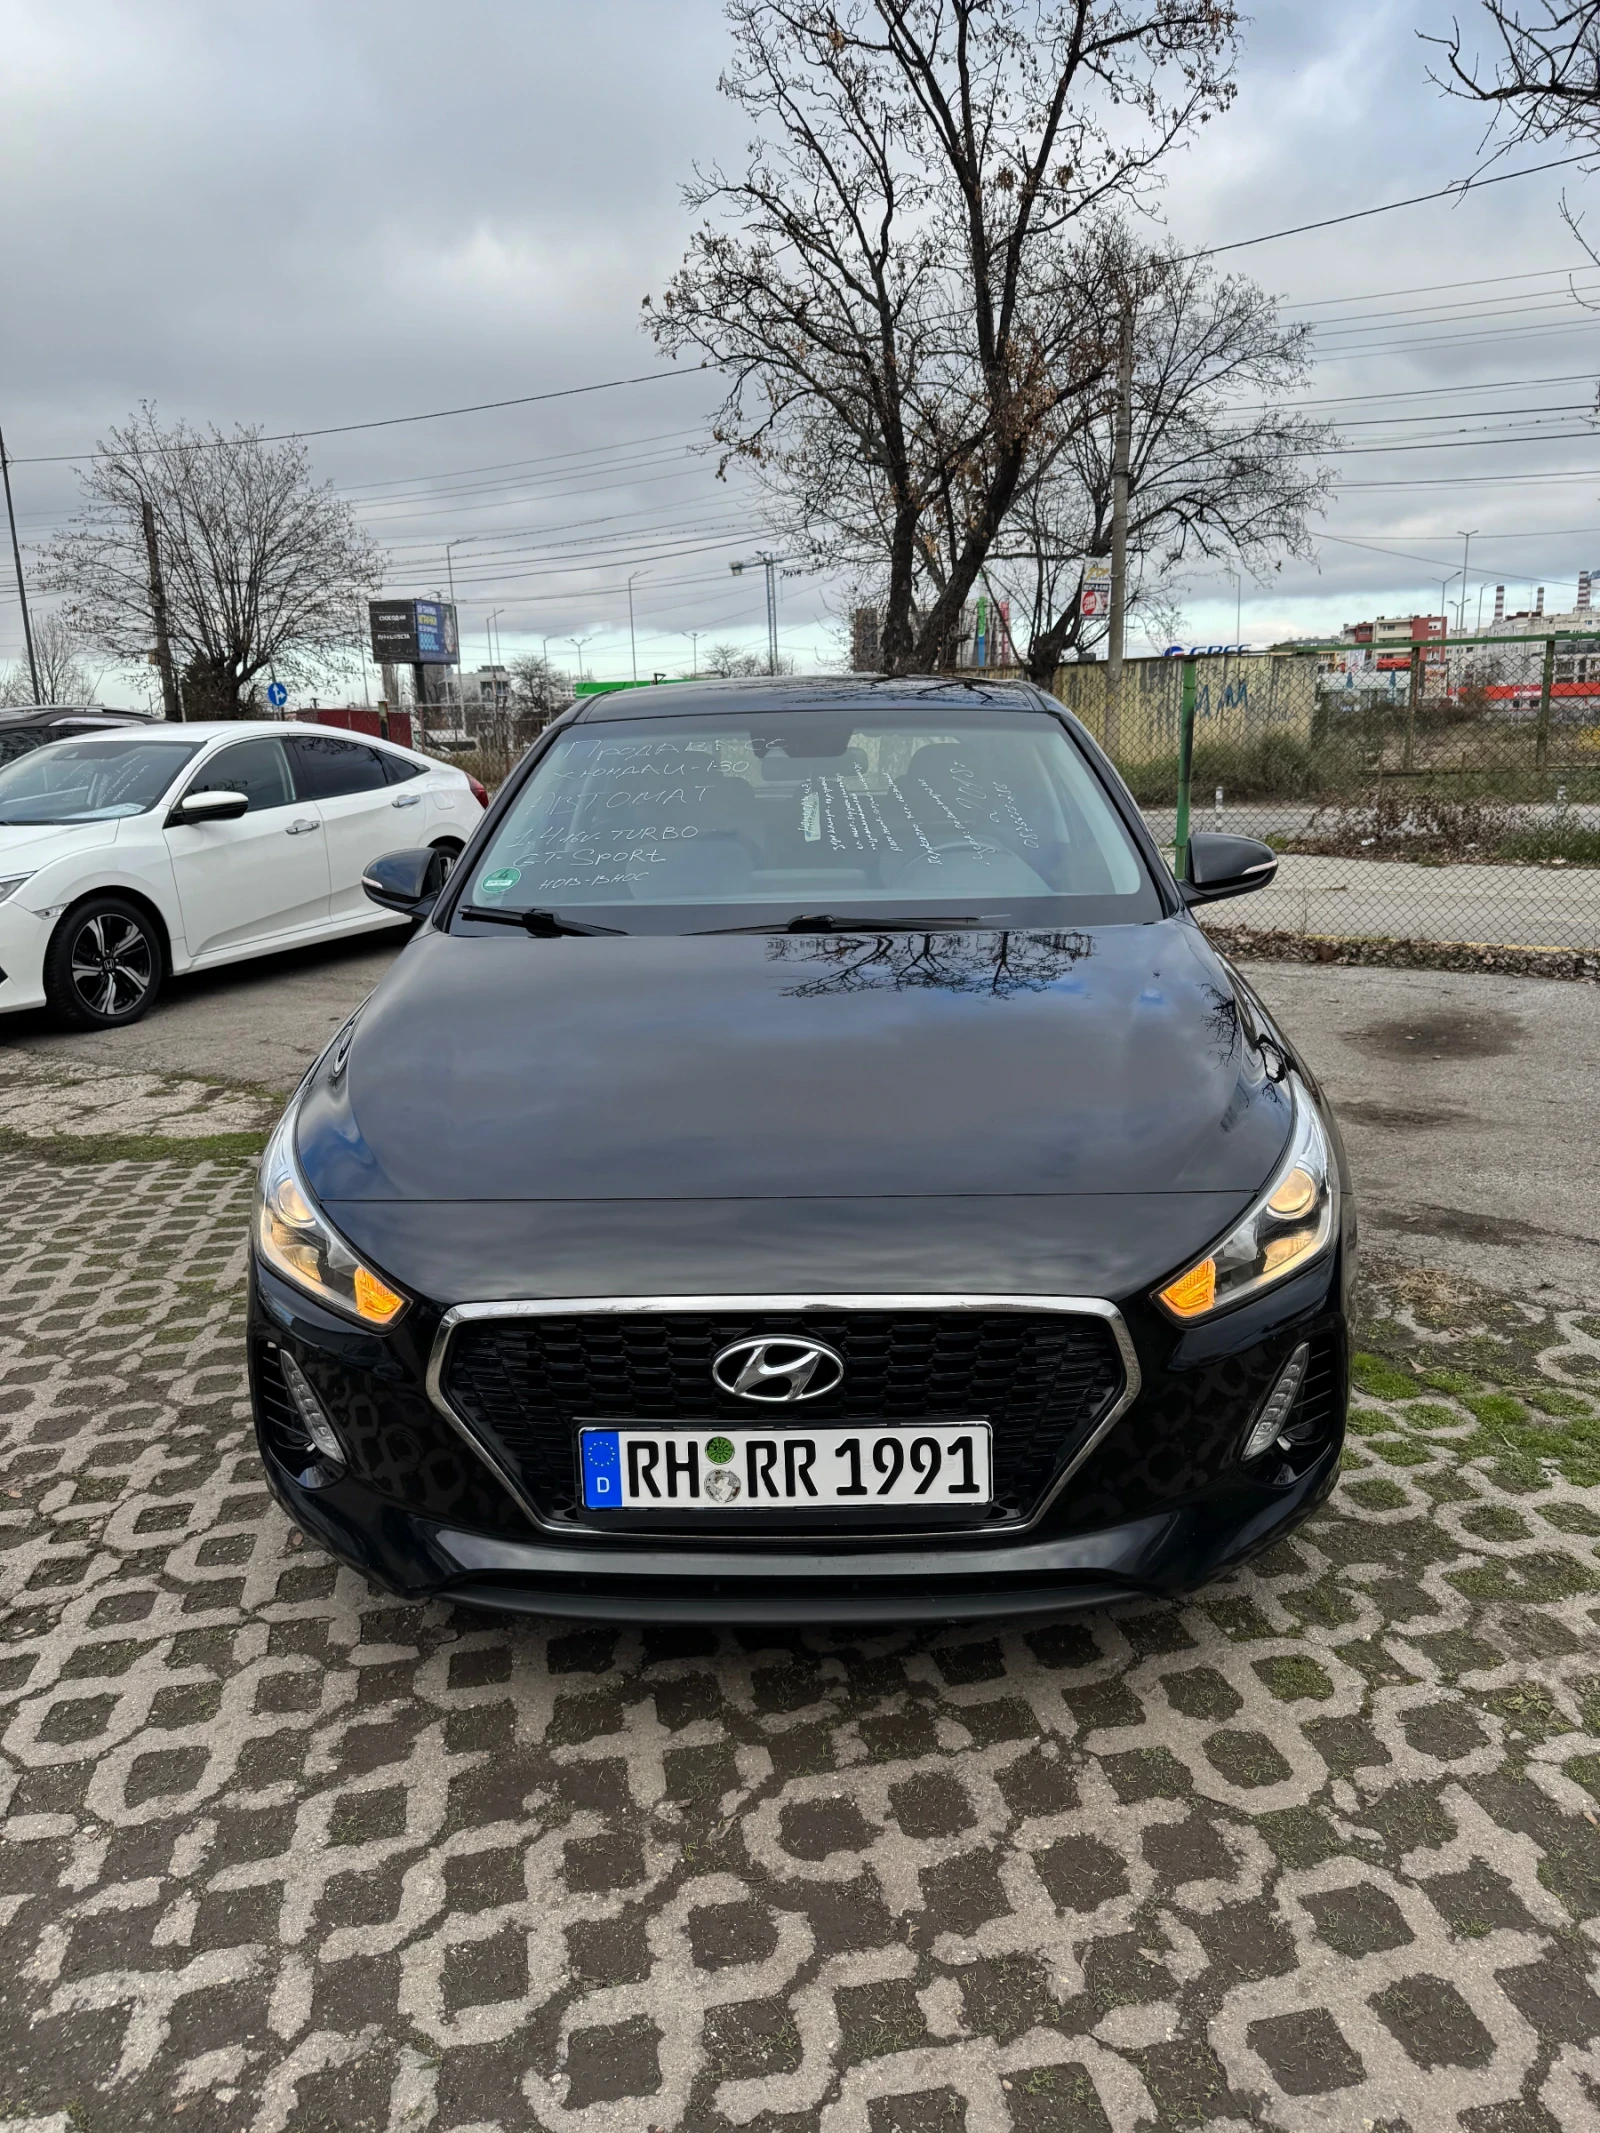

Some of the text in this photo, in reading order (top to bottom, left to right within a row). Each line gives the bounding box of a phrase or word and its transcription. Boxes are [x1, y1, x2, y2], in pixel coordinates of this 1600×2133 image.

[612, 826, 699, 841] TURBO
[497, 868, 511, 880] 4
[626, 1436, 981, 1498] RH RR 1991
[596, 1476, 610, 1494] D
